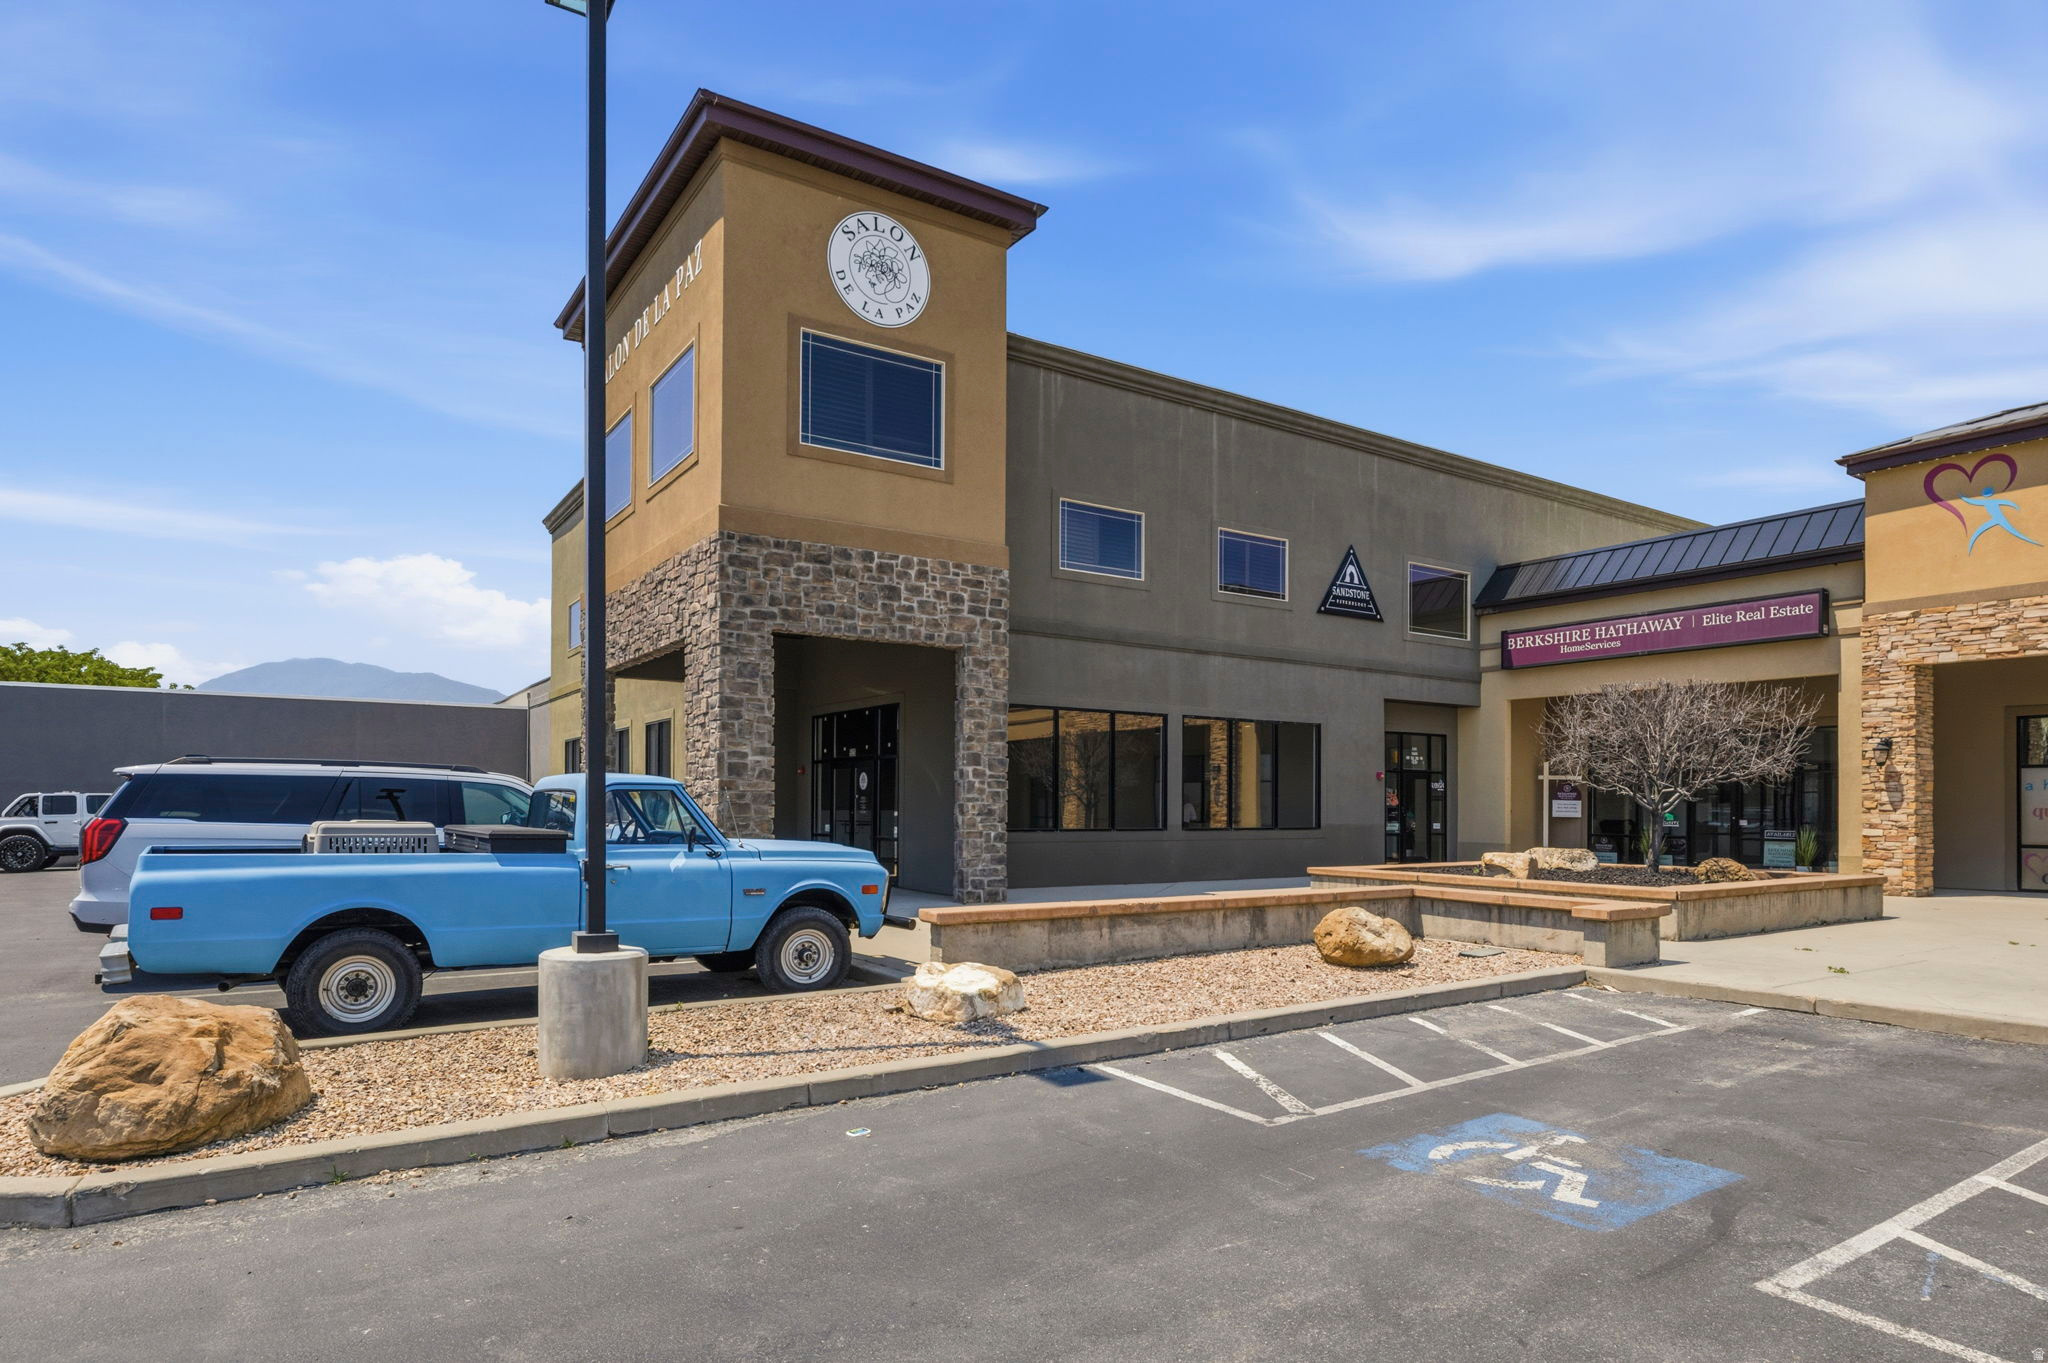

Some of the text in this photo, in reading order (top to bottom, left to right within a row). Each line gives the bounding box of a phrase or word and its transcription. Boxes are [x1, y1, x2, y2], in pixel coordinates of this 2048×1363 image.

[841, 216, 920, 261] SALON
[605, 239, 703, 384] LON DE LA PAZ
[836, 269, 921, 319] DE LA PAZ
[1332, 586, 1370, 600] SANDSTONE
[1507, 604, 1814, 650] BERKSHIRE HATHAWAY Elite Real Estate
[1560, 640, 1621, 654] HomeServices
